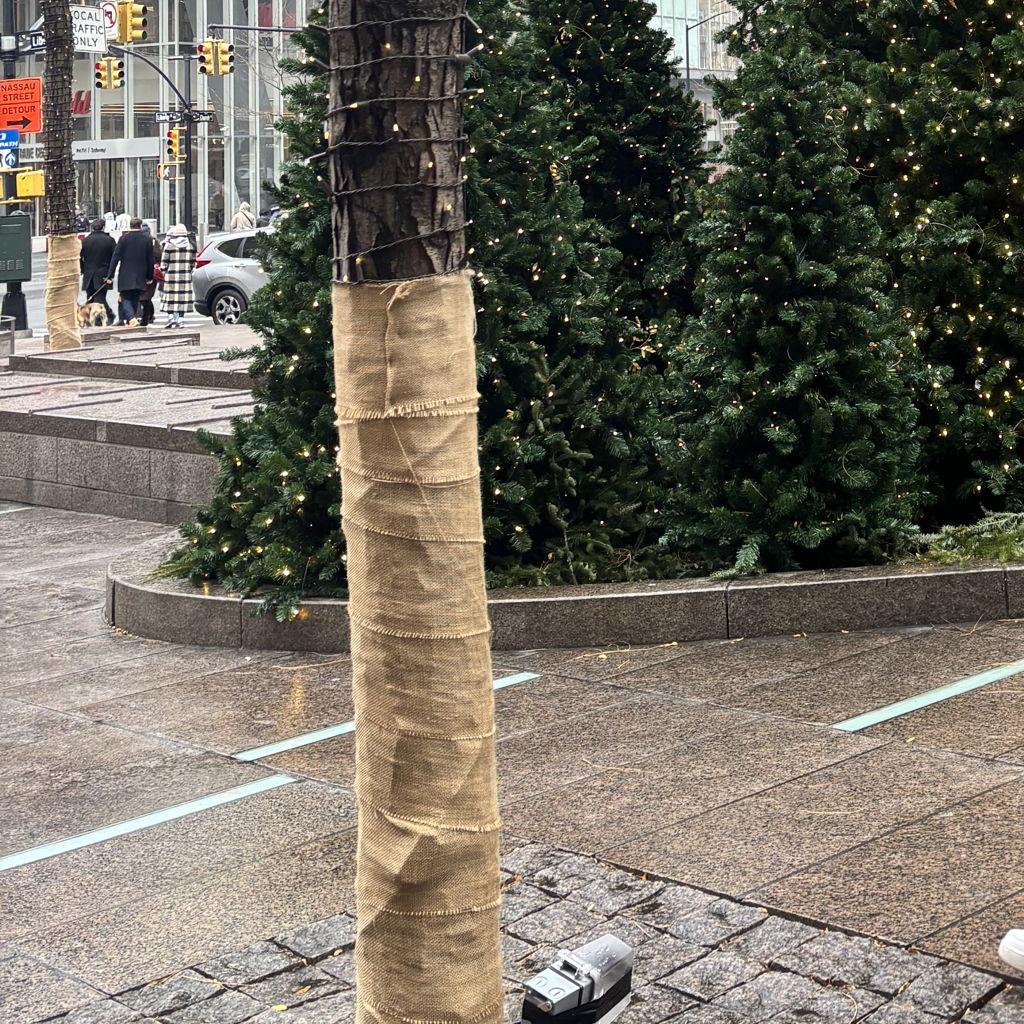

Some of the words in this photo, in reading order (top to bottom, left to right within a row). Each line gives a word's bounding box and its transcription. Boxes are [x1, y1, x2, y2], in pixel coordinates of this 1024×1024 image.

[73, 10, 101, 22] OCAL
[72, 22, 104, 35] RAFFIC
[1, 82, 36, 92] NASSAU
[3, 92, 35, 102] STREET
[2, 105, 36, 115] DETOUR
